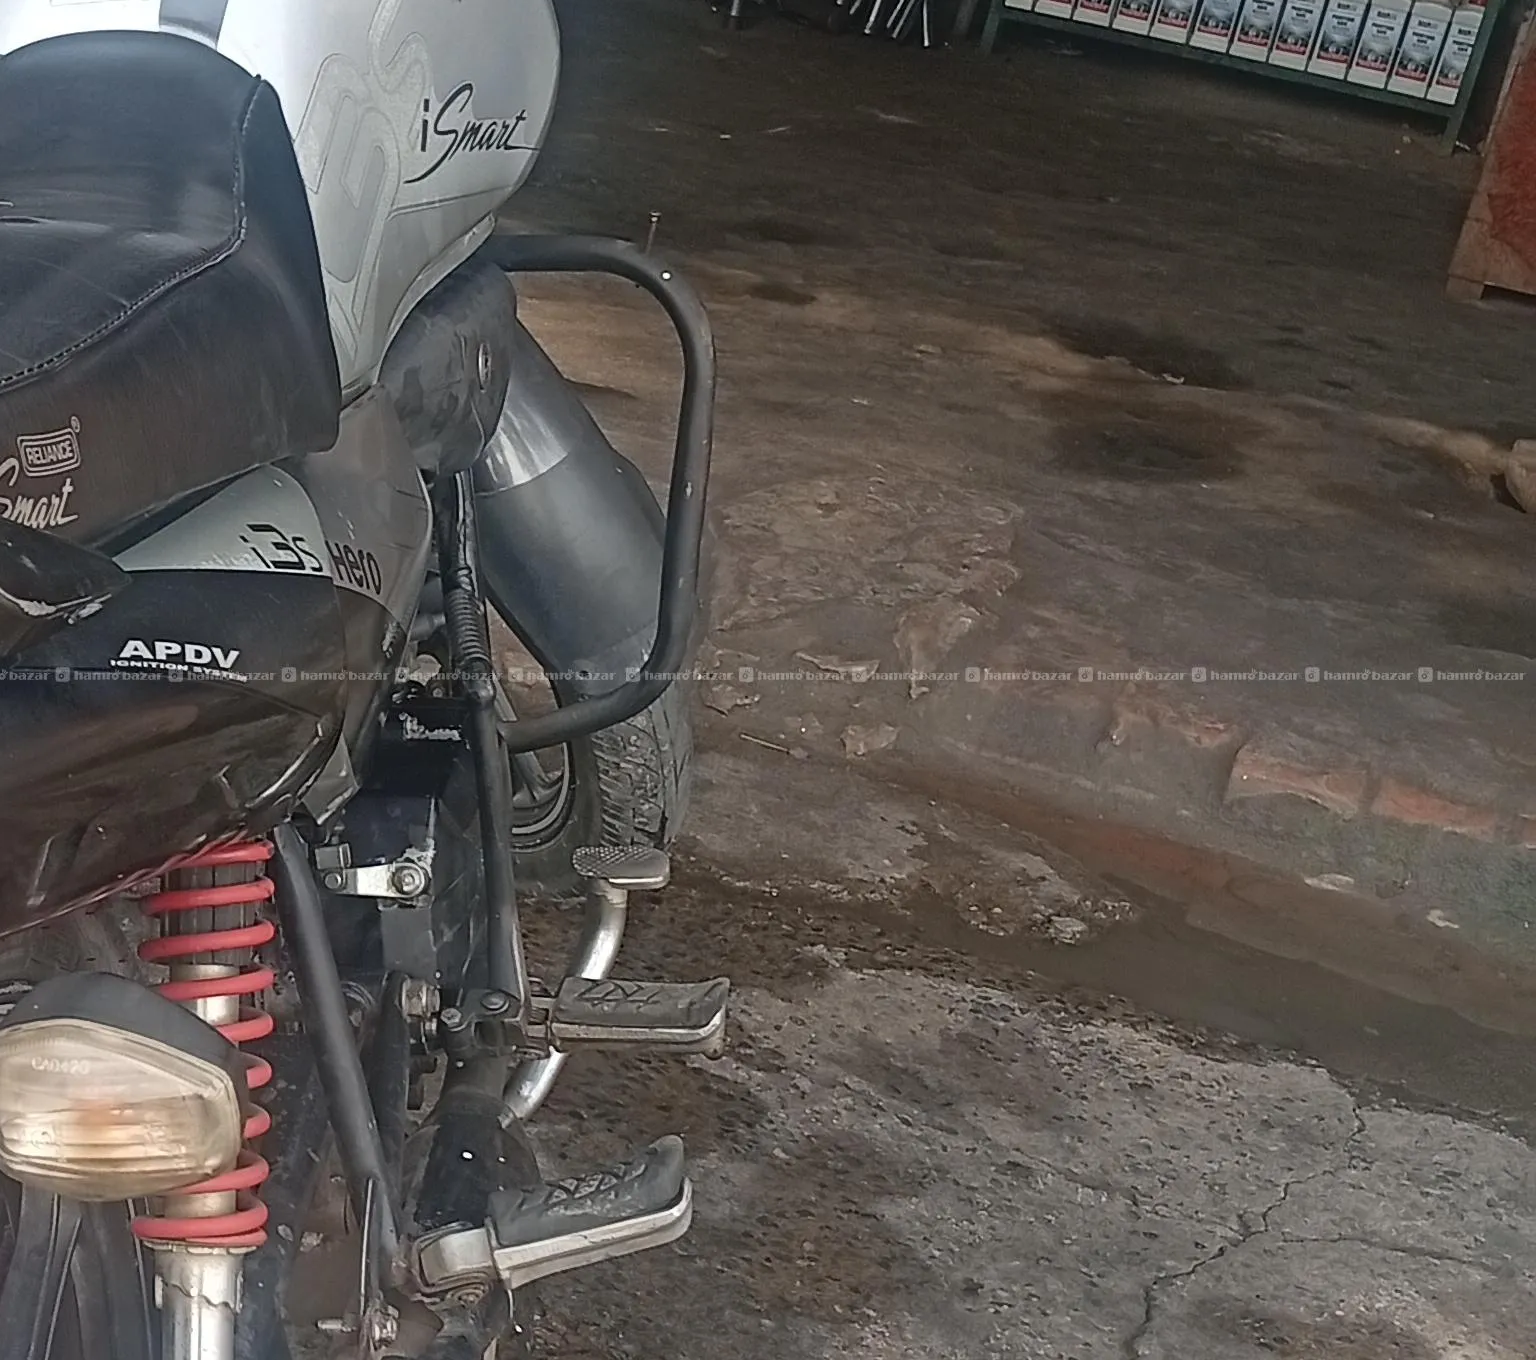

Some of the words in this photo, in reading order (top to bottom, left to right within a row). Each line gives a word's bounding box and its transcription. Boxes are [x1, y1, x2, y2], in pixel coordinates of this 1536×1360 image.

[25, 440, 74, 465] RELIANCE
[325, 540, 381, 595] Hero
[110, 659, 189, 672] IGNITION
[119, 639, 240, 669] APDV
